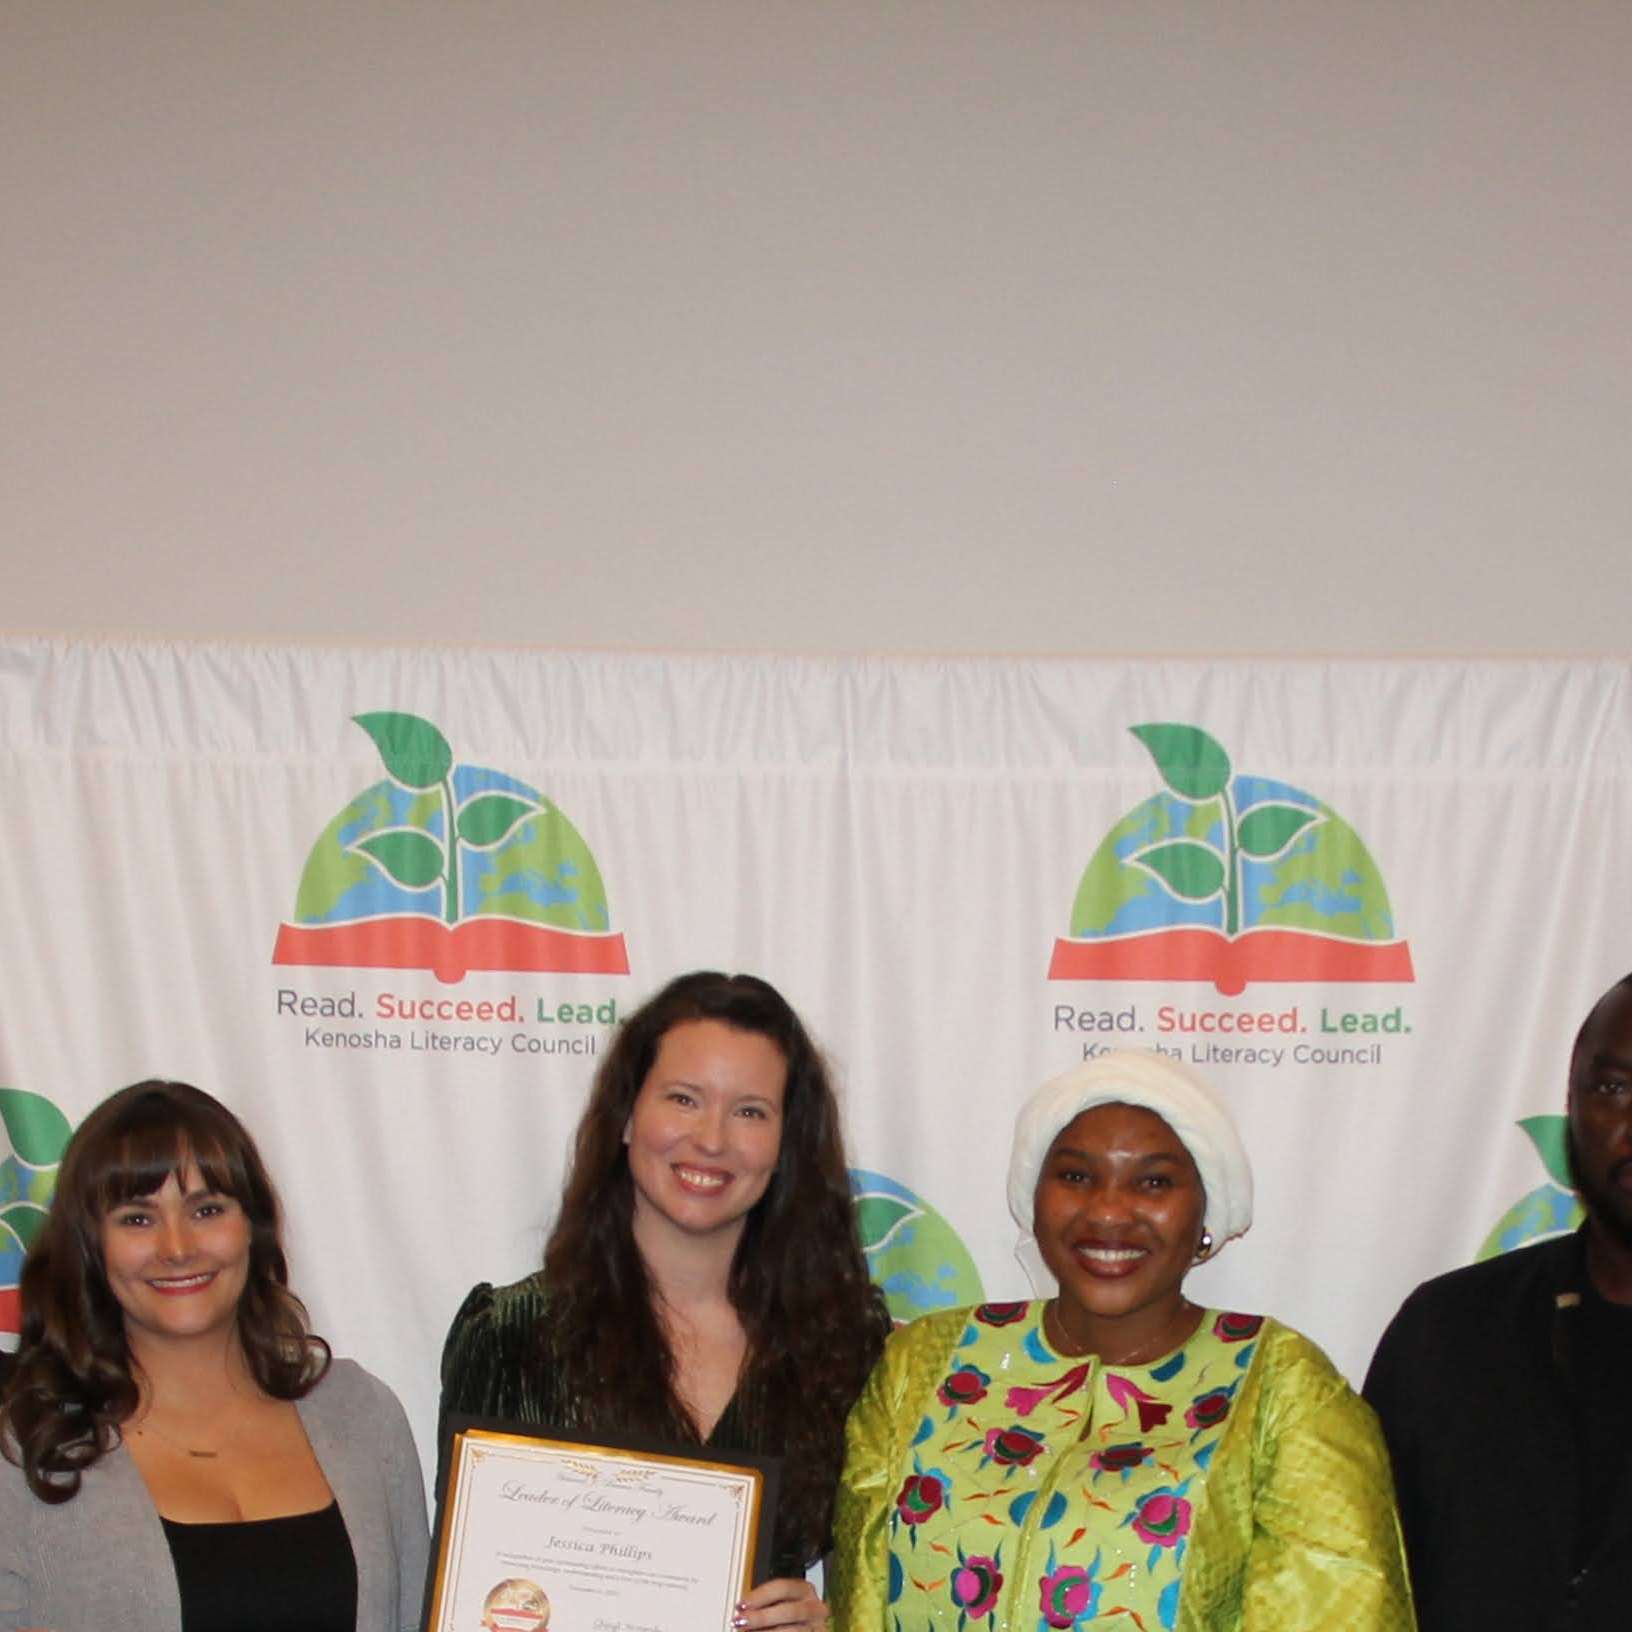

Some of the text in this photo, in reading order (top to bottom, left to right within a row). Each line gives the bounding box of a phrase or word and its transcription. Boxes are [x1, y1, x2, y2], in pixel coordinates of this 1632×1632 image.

[276, 989, 364, 1019] Read.
[376, 993, 524, 1022] Succeed.
[1054, 1005, 1411, 1033] Read. Succeed. Lead.
[304, 1028, 597, 1055] Kenosha Literacy Council
[1191, 1043, 1284, 1067] Literacy
[1293, 1044, 1382, 1065] Council
[498, 1479, 559, 1506] Leader
[561, 1492, 578, 1510] of
[579, 1490, 647, 1522] Literacy
[651, 1501, 717, 1527] Award
[545, 1536, 653, 1561] Jessica Phillips
